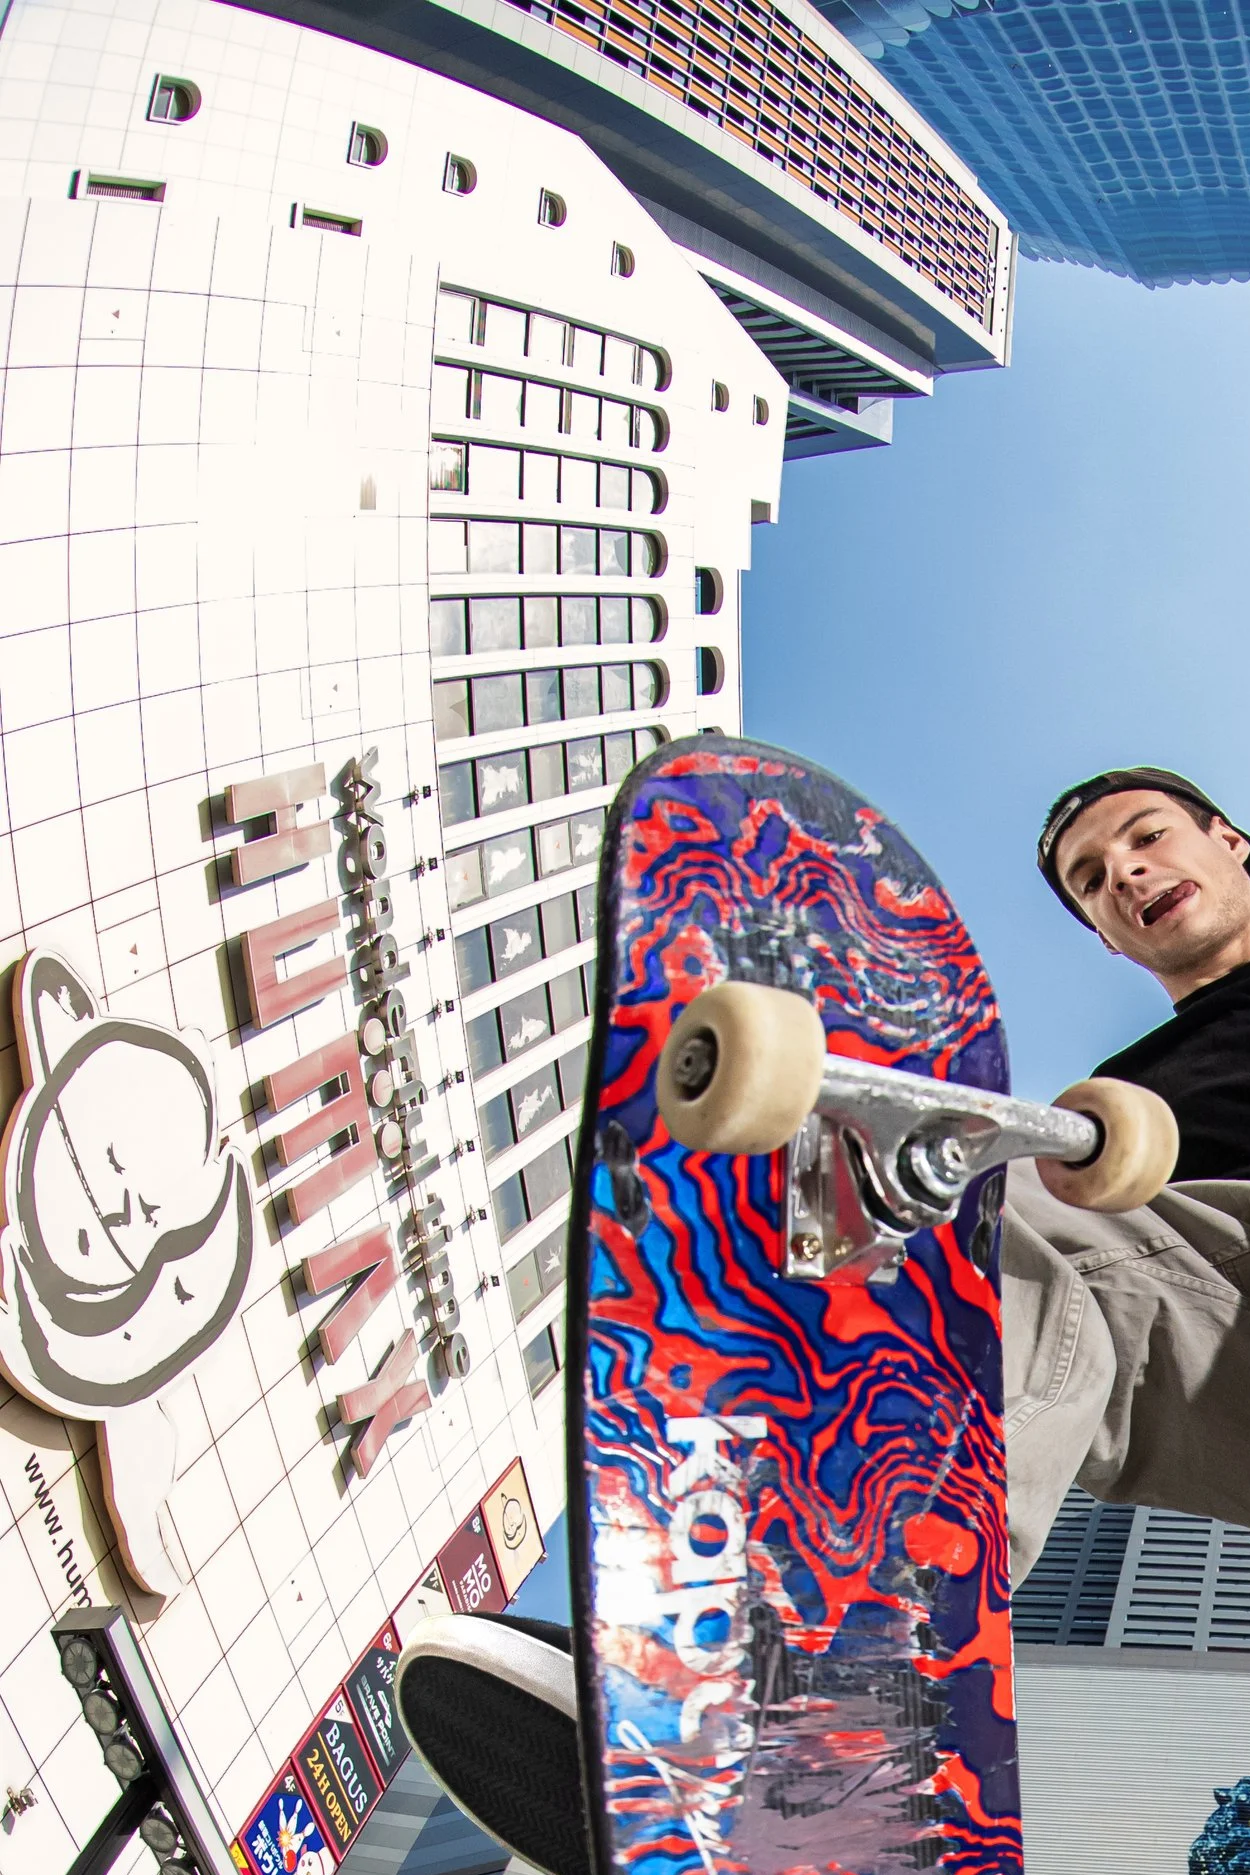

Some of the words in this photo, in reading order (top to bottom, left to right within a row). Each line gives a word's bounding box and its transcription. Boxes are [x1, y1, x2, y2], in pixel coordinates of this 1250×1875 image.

[345, 745, 440, 1188] Wonderful
[414, 1191, 471, 1380] time
[23, 1452, 94, 1608] www.hum
[360, 1674, 381, 1721] BRAVE
[377, 1719, 397, 1757] POINT
[306, 1748, 331, 1796] 24H
[325, 1791, 352, 1843] OPEN
[325, 1722, 368, 1814] BAGUS
